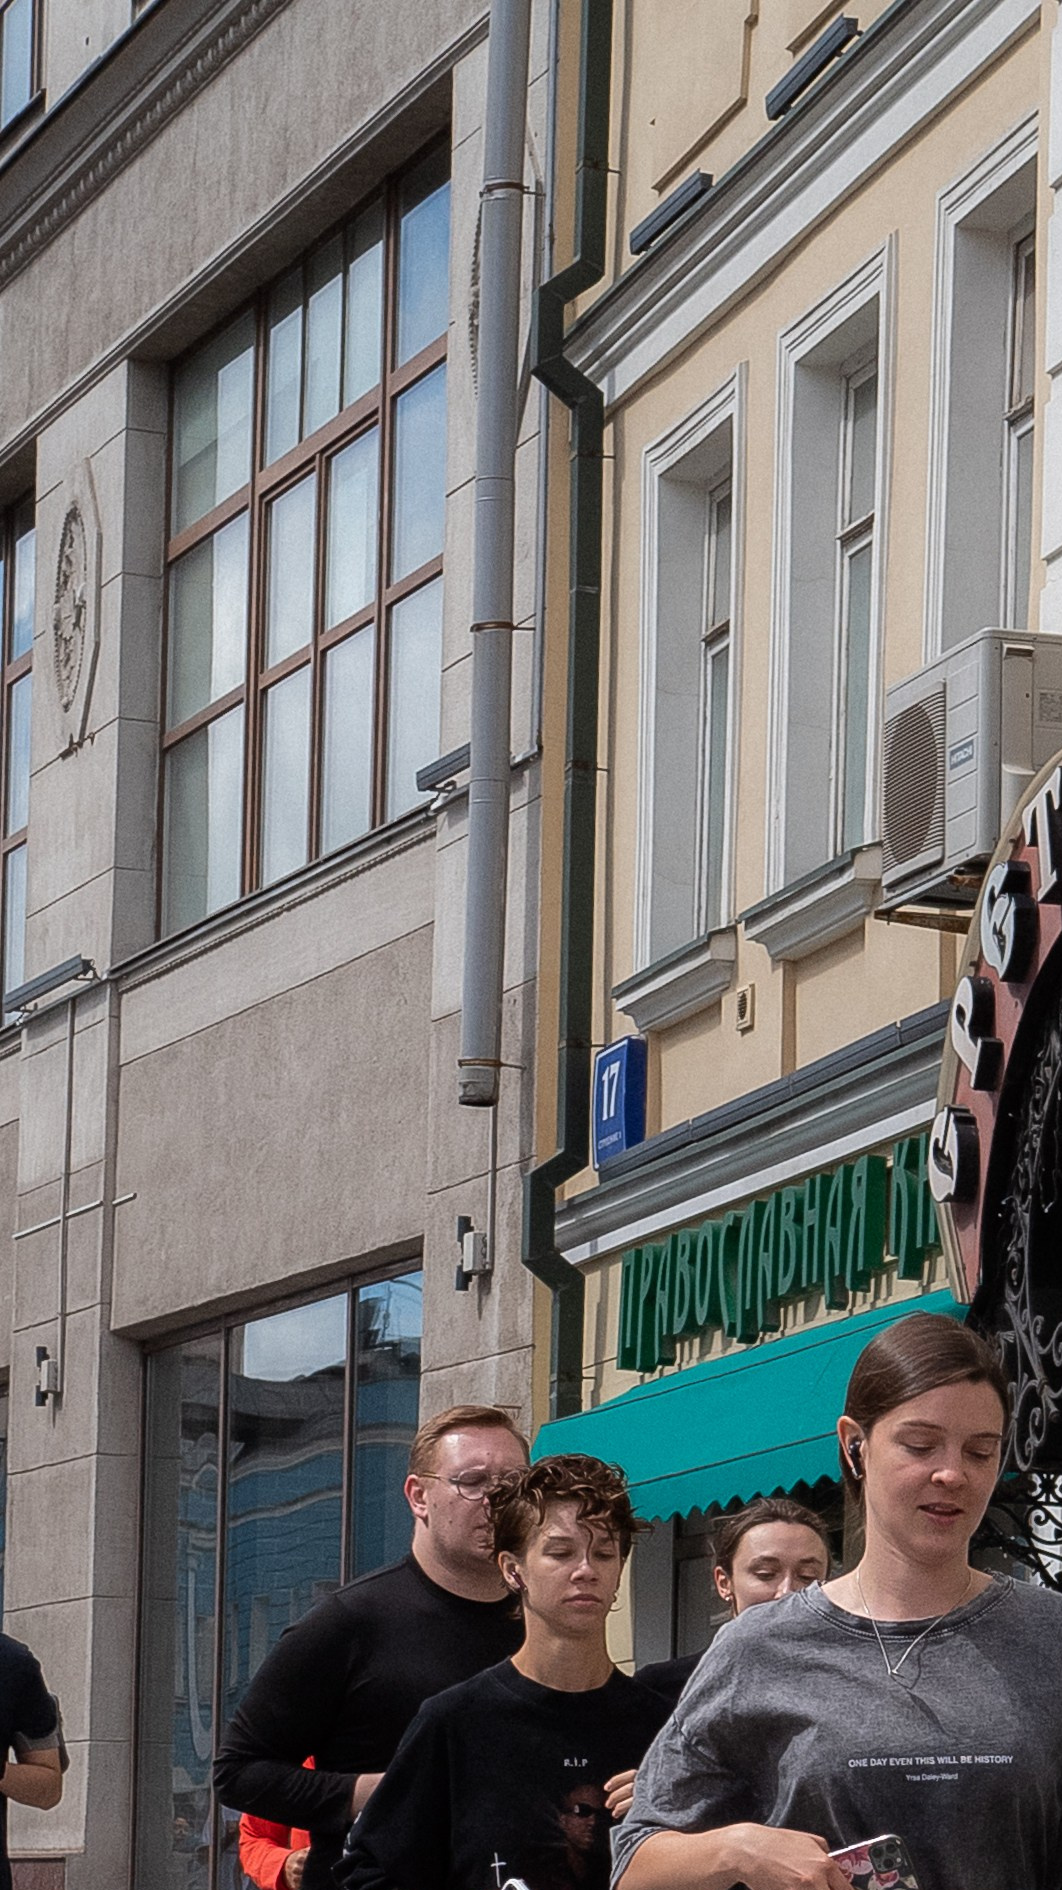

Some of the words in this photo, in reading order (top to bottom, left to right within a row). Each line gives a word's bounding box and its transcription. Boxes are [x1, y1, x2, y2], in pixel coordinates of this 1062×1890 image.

[950, 745, 973, 765] HITACHI
[602, 1060, 621, 1121] 17
[616, 1154, 887, 1372] ПРАВОСЛАВНАЯ
[848, 1758, 868, 1768] ONE
[869, 1757, 888, 1767] DAY
[889, 1757, 913, 1767] EVEN
[914, 1756, 935, 1766] THIS
[937, 1755, 959, 1765] WILL
[960, 1755, 973, 1764] BE
[974, 1755, 1014, 1764] HISTORY
